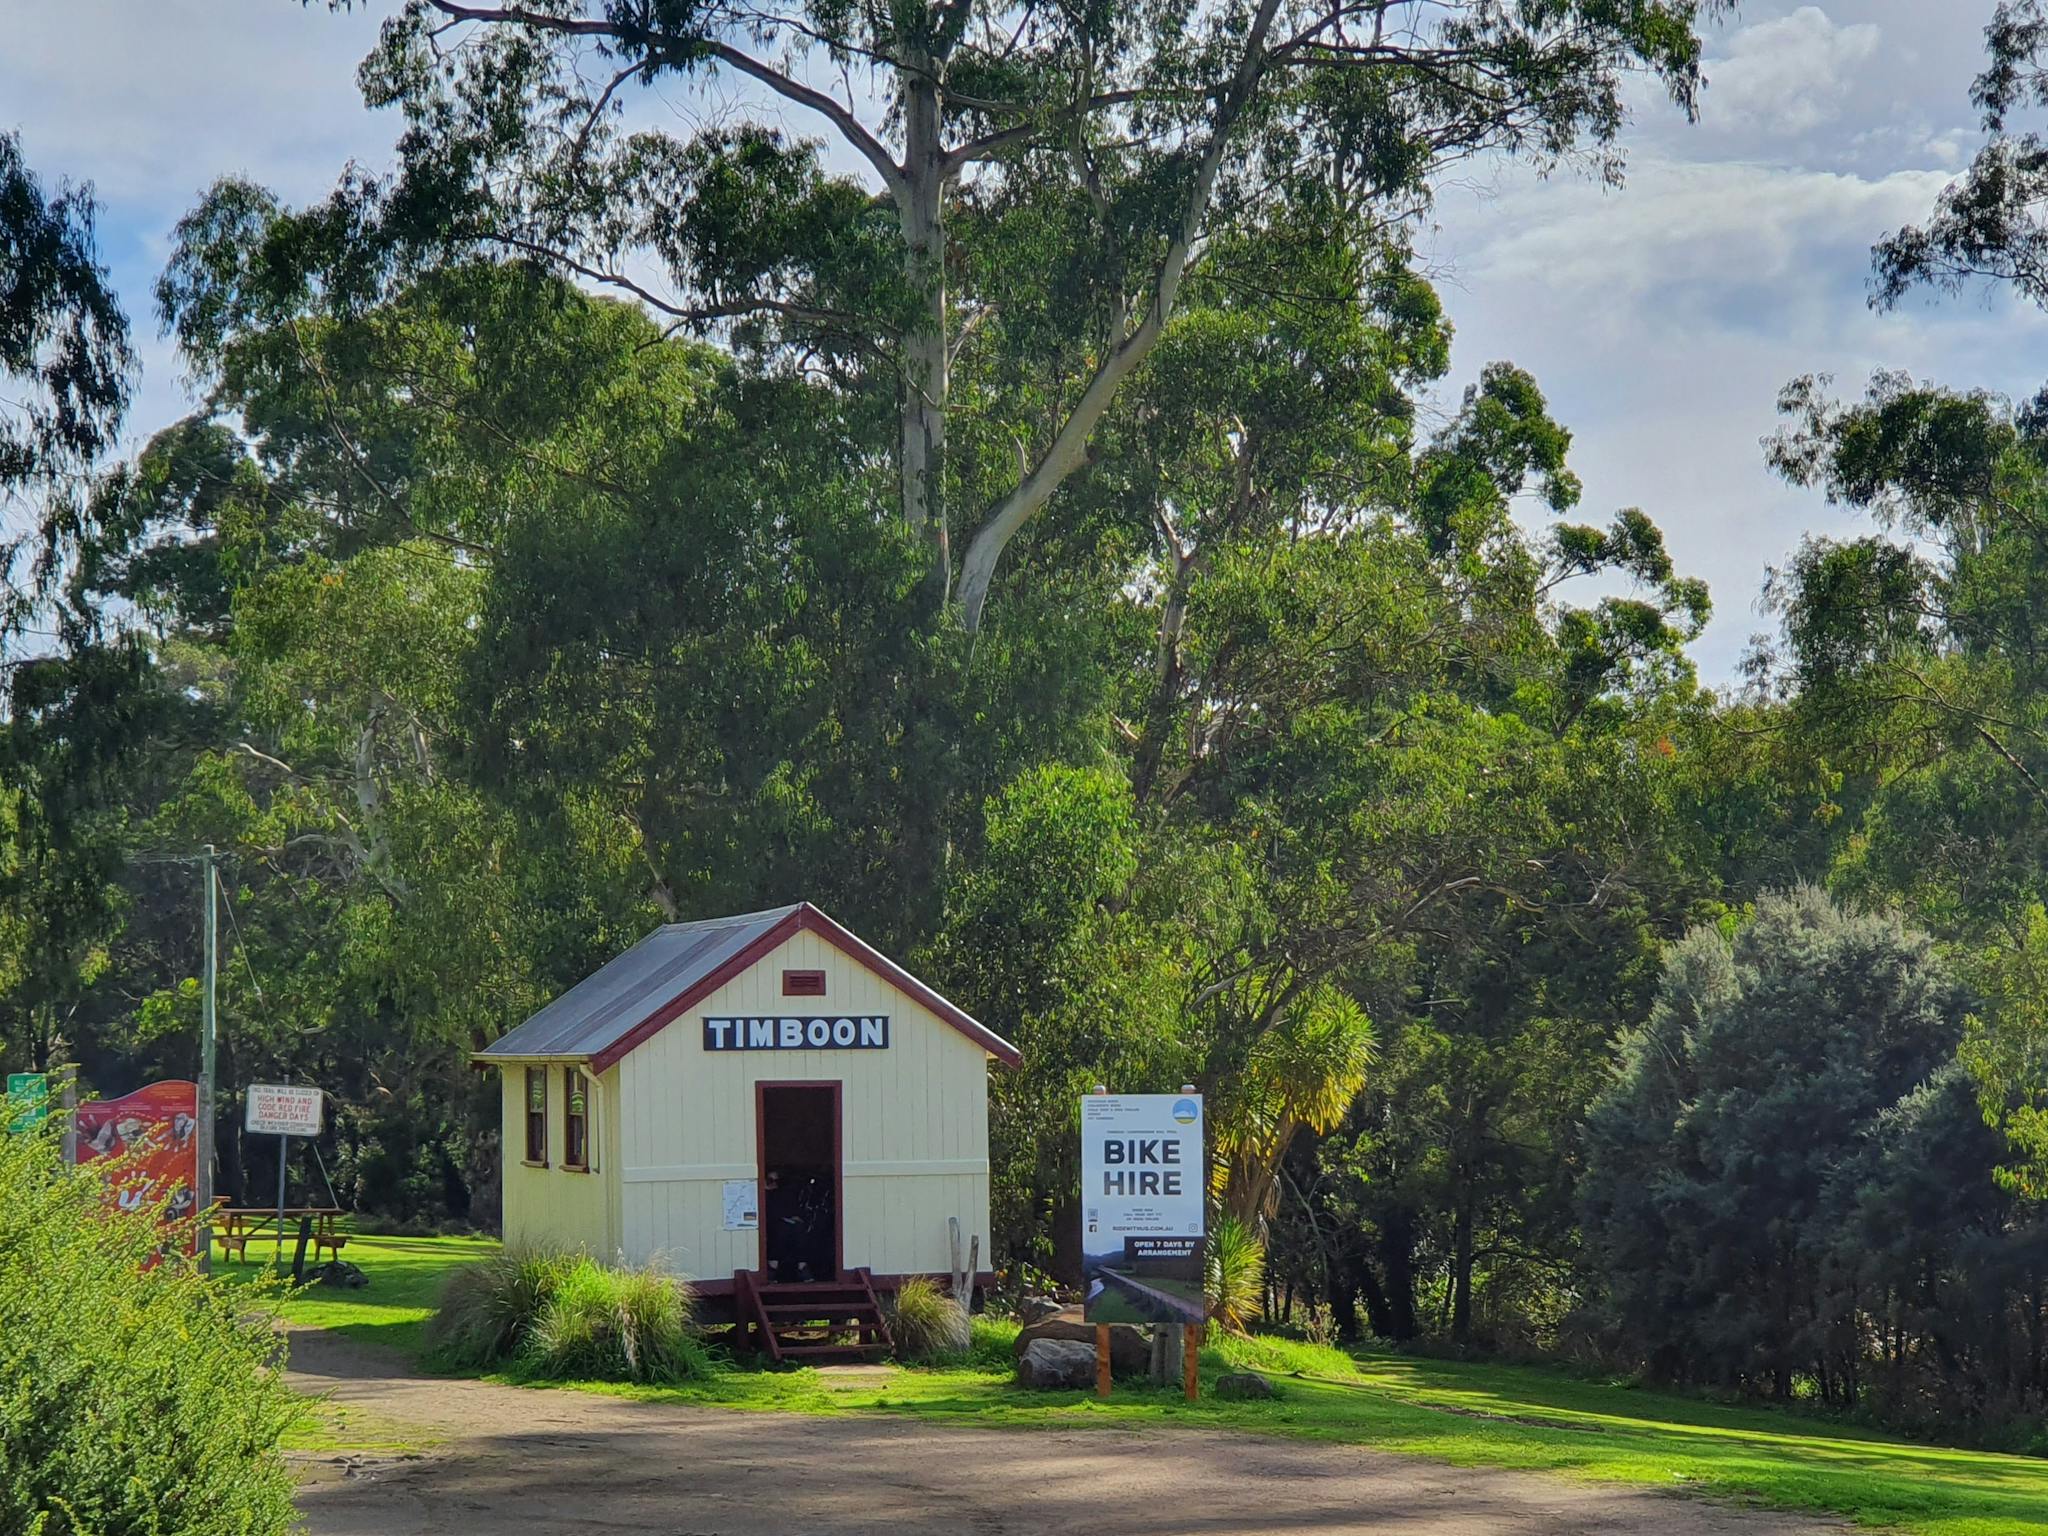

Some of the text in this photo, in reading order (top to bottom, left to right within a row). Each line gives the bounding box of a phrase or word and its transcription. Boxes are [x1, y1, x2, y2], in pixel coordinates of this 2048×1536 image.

[708, 1018, 884, 1049] TIMBOON
[257, 1094, 313, 1105] HIGH WIND AND
[257, 1103, 310, 1113] CODE RED FIRE
[258, 1111, 309, 1121] DANGER DAYS
[1104, 1139, 1181, 1165] BIKE
[1103, 1170, 1182, 1196] HIRE
[1134, 1240, 1195, 1248] OPEN 7 DAYS BY
[1137, 1249, 1192, 1257] ARRANGEMENT
